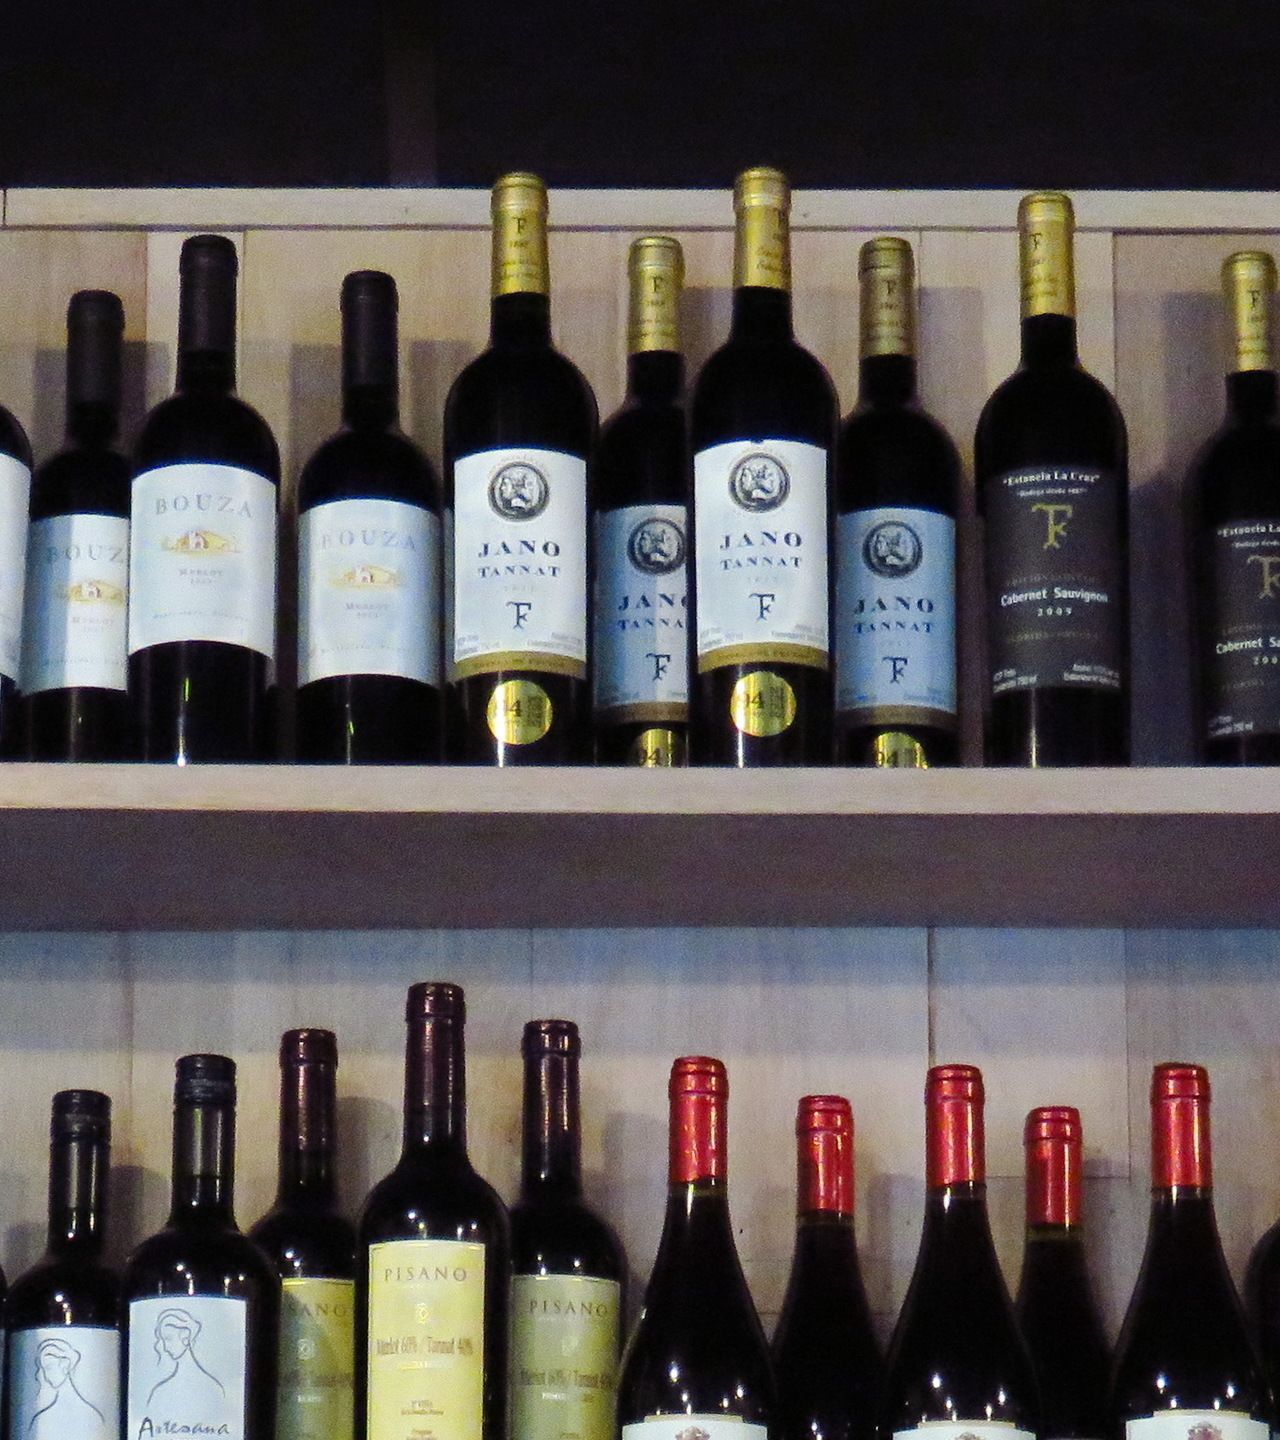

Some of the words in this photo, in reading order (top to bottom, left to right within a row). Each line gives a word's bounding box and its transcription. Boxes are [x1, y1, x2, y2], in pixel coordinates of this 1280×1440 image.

[1054, 471, 1068, 481] La
[155, 494, 253, 519] BOUZA
[321, 529, 417, 552] BOUZA
[719, 530, 803, 551] JANO
[46, 544, 125, 565] BOUZ
[478, 539, 561, 560] JANO
[478, 564, 561, 580] TANNAT
[720, 556, 803, 571] TANNAT
[854, 595, 934, 615] JANO
[1000, 588, 1048, 607] Cabernet
[1054, 586, 1110, 604] Sauvignon
[617, 617, 684, 632] TANNA
[853, 621, 933, 635] TANNAT
[1216, 638, 1264, 655] Cabernet
[385, 1265, 468, 1282] PISANO
[530, 1300, 608, 1317] PISANO
